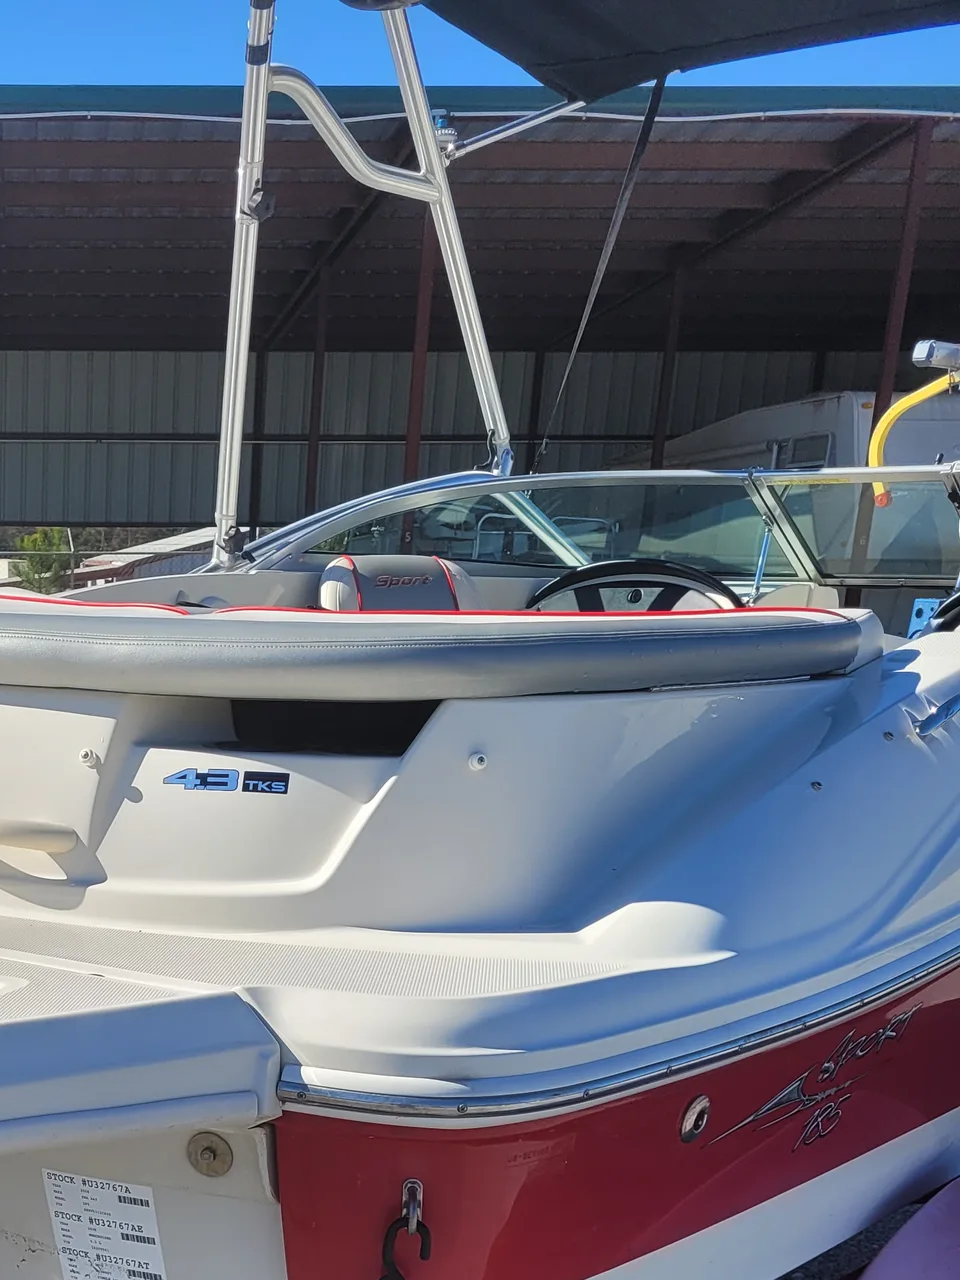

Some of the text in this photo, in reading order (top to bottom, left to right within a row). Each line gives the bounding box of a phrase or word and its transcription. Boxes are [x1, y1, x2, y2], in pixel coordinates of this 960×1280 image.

[375, 575, 432, 588] Sport
[245, 780, 286, 792] TKS
[791, 1093, 851, 1152] 185
[47, 1172, 131, 1193] STOCK #U32767A
[55, 1210, 83, 1222] STOCK
[88, 1217, 143, 1232] #U32767AE
[62, 1246, 90, 1258] STOCK
[96, 1253, 150, 1269] #U32767AT
